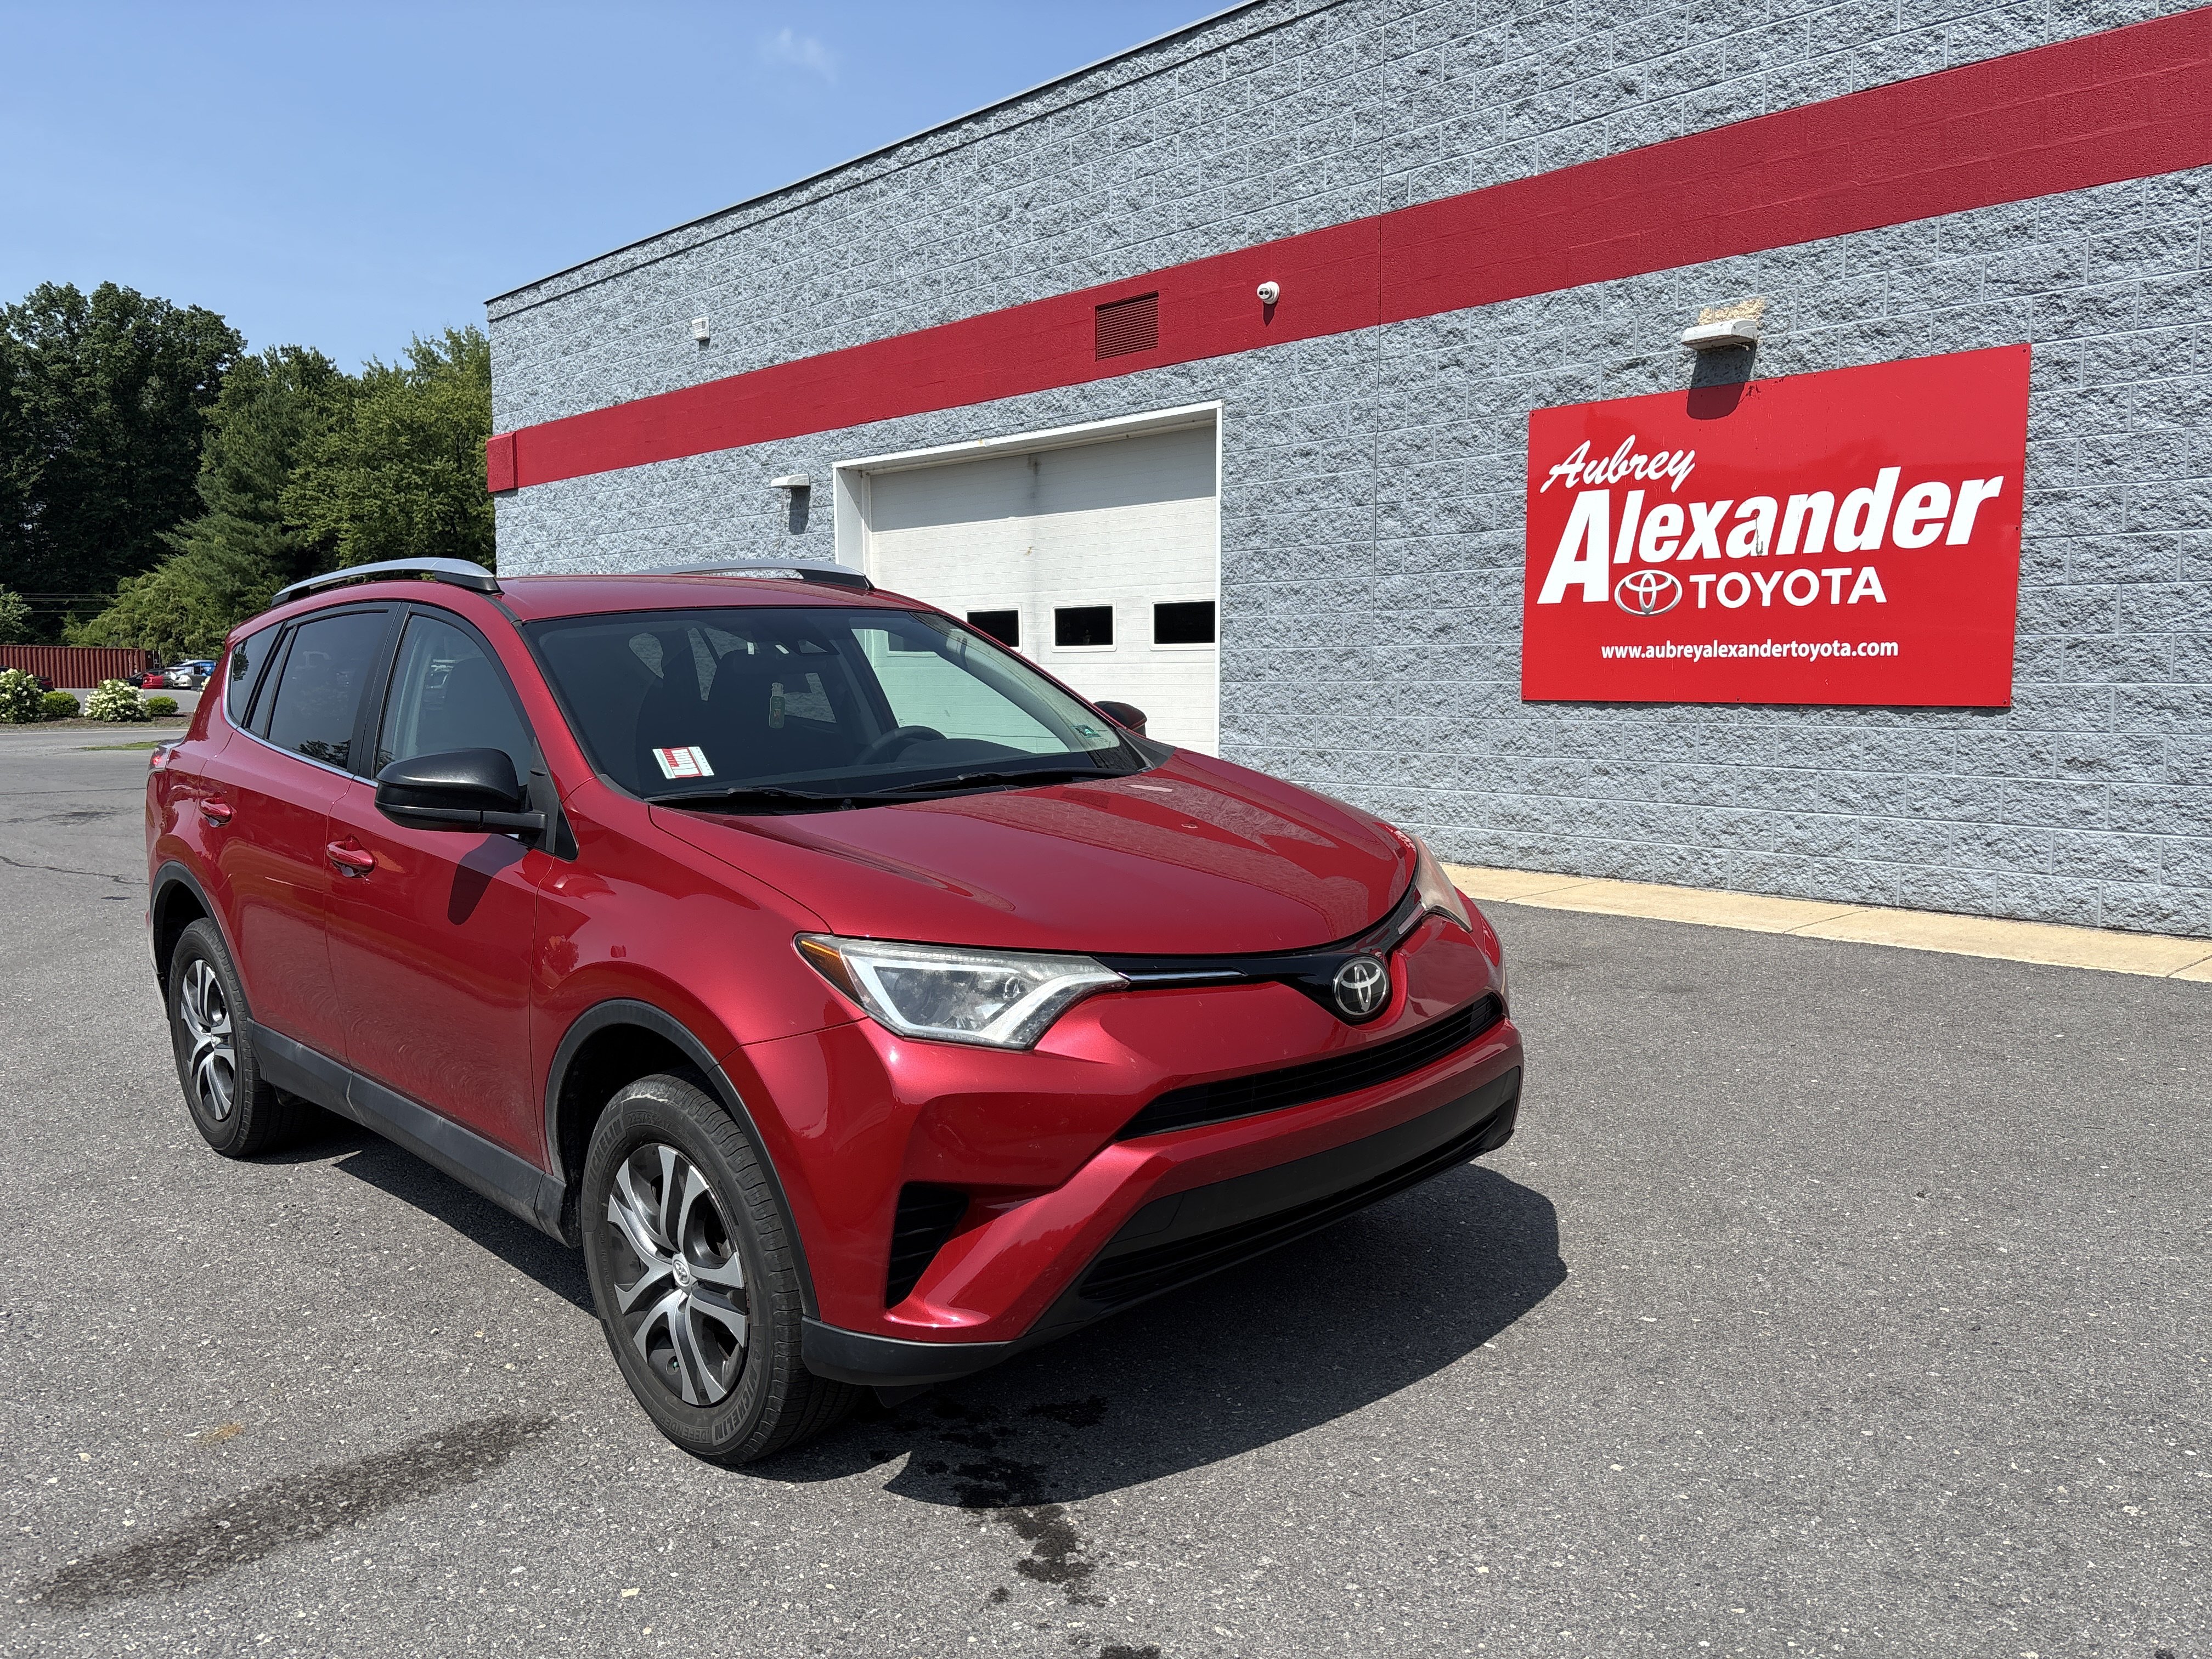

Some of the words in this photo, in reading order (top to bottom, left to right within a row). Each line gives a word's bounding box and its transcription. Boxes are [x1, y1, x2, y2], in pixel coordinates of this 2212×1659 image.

[1540, 435, 1695, 493] Aubrey
[1537, 466, 2005, 605] Alexander
[1689, 567, 1887, 609] TOYOTA
[1601, 639, 1899, 663] www.aubreyalexandertoyota.com
[660, 1413, 707, 1442] DEFENDER
[714, 1363, 758, 1442] MICHELIN
